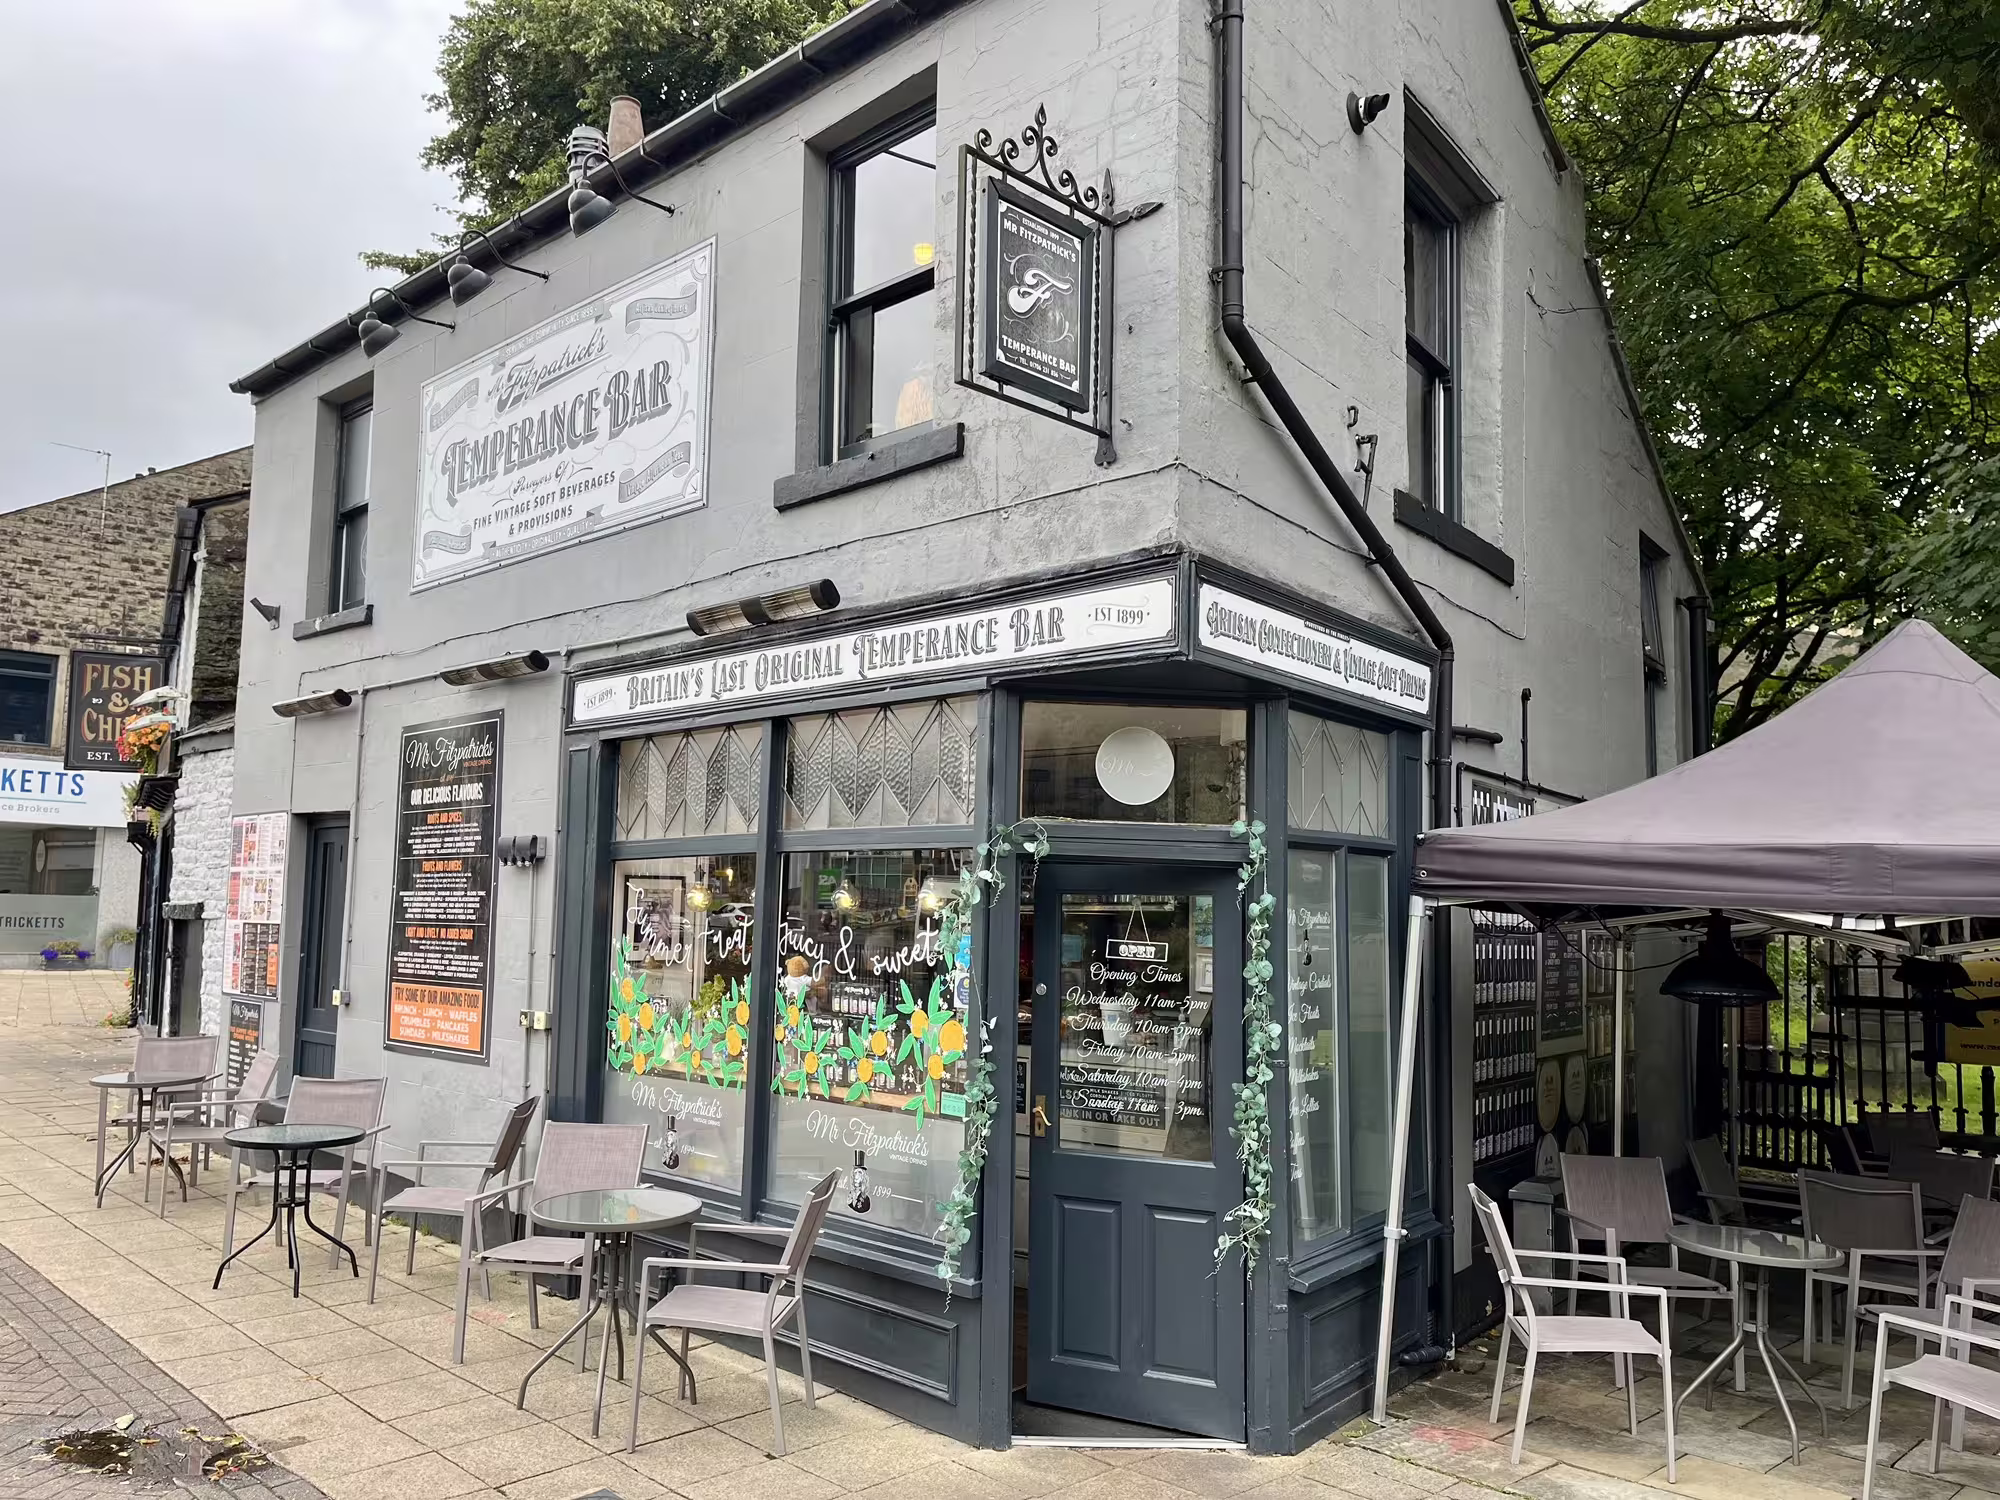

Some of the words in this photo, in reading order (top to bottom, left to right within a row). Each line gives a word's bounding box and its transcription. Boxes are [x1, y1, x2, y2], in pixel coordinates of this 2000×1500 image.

[1003, 218, 1018, 235] MR
[1019, 226, 1076, 263] FITZPATRICK'S
[564, 311, 580, 326] SINCE
[1001, 334, 1058, 366] TEMPERANCE
[1059, 358, 1076, 375] BAR
[496, 326, 609, 414] Fitzpatrick's
[441, 387, 600, 505] TEMPERANCE
[603, 359, 674, 440] BAR
[473, 514, 493, 531] FINE
[495, 500, 531, 522] VINTAGE
[533, 491, 556, 510] SOFT
[559, 470, 616, 499] BEVERAGES
[508, 522, 515, 537] &
[518, 504, 573, 534] PROVISIONS
[1094, 607, 1112, 622] EST
[1116, 609, 1144, 626] 1899
[627, 666, 704, 710] BRITAIN'S
[710, 658, 749, 701] LAST
[754, 643, 844, 691] ORIGINAL
[852, 616, 1000, 680] TEMPERANCE
[1008, 606, 1066, 652] BAR
[1206, 600, 1257, 647] ARTISAN
[1257, 618, 1333, 672] CONFECTIONERY
[1333, 648, 1343, 675] &
[1343, 647, 1377, 685] VINTAGE
[1377, 661, 1400, 691] SOFT
[1399, 668, 1427, 702] DRINKS
[83, 663, 152, 696] FISH
[108, 692, 130, 713] &
[598, 688, 613, 703] 1899
[87, 751, 113, 761] EST.
[406, 739, 430, 769] Mr
[410, 789, 423, 806] OUR
[422, 784, 452, 805] DELICIOUS
[452, 782, 483, 802] FLAVOURS
[17, 803, 60, 814] Brokers
[424, 927, 439, 939] LOVELY
[459, 928, 474, 941] SUGAR
[626, 881, 693, 972] Summer
[698, 914, 755, 966] treat
[834, 925, 857, 981] &
[1118, 943, 1156, 959] OPEN
[1089, 962, 1139, 987] Opening
[1141, 964, 1183, 983] Times
[395, 986, 404, 1001] TRY
[405, 988, 419, 1002] SOME
[420, 989, 427, 1003] OF
[427, 990, 438, 1004] OUR
[438, 990, 463, 1007] AMAZING
[463, 994, 480, 1009] FOOD!
[1066, 986, 1141, 1013] Wednesday
[1143, 992, 1209, 1016] 11am-5pm
[394, 1004, 417, 1015] BRUNCH
[422, 1007, 443, 1018] LUNCH
[449, 1010, 478, 1023] WAFFLES
[400, 1015, 431, 1027] CRUMBLES
[436, 1020, 469, 1033] PANCAKES
[1071, 1012, 1133, 1037] Thursday
[1134, 1019, 1203, 1040] 10am-5pm
[399, 1027, 426, 1039] SUNDAES
[431, 1032, 470, 1045] MILKSHAKES
[1077, 1038, 1126, 1064] Friday
[1129, 1044, 1197, 1066] 10am-5pm
[1071, 1063, 1132, 1090] Saturday
[1134, 1068, 1204, 1090] 10am-4pm
[631, 1081, 656, 1110] Mr
[658, 1087, 723, 1120] Fitzpatrick's
[1071, 1089, 1124, 1116] Sunday
[1082, 1110, 1092, 1120] IN
[1095, 1111, 1109, 1122] OR
[1111, 1113, 1136, 1124] TAKE
[1138, 1116, 1160, 1128] OUT
[806, 1109, 839, 1141] Mr
[842, 1117, 930, 1158] Fitzpatrick's
[888, 1153, 909, 1163] VINTAGE
[909, 1156, 928, 1167] DRINKS
[872, 1185, 892, 1199] 1899
